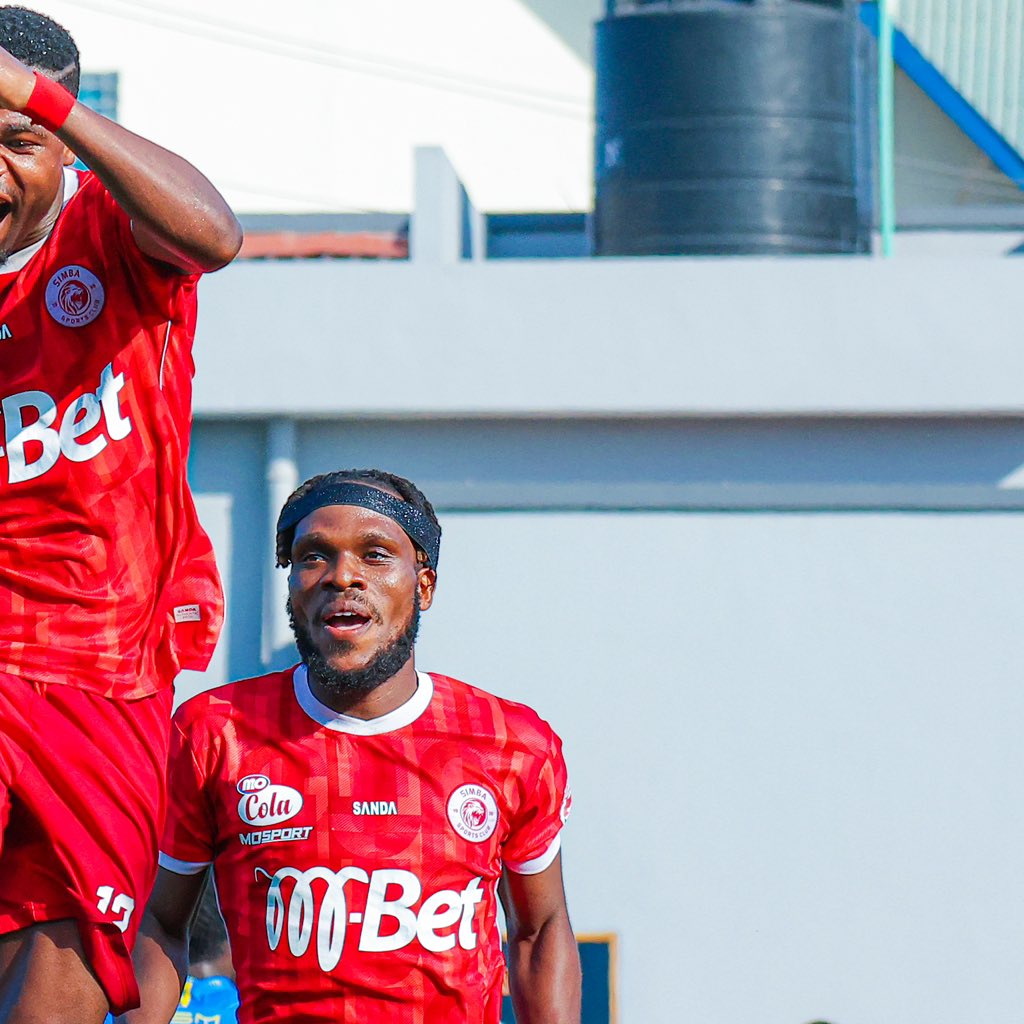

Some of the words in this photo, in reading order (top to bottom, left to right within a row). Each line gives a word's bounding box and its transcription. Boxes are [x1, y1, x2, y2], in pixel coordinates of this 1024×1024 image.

[53, 269, 81, 288] SIMBA
[459, 788, 487, 800] SIMBA
[246, 792, 292, 821] Cola
[352, 801, 398, 815] SANDA
[239, 826, 313, 846] MOSPORT
[254, 866, 485, 972] M-Bet
